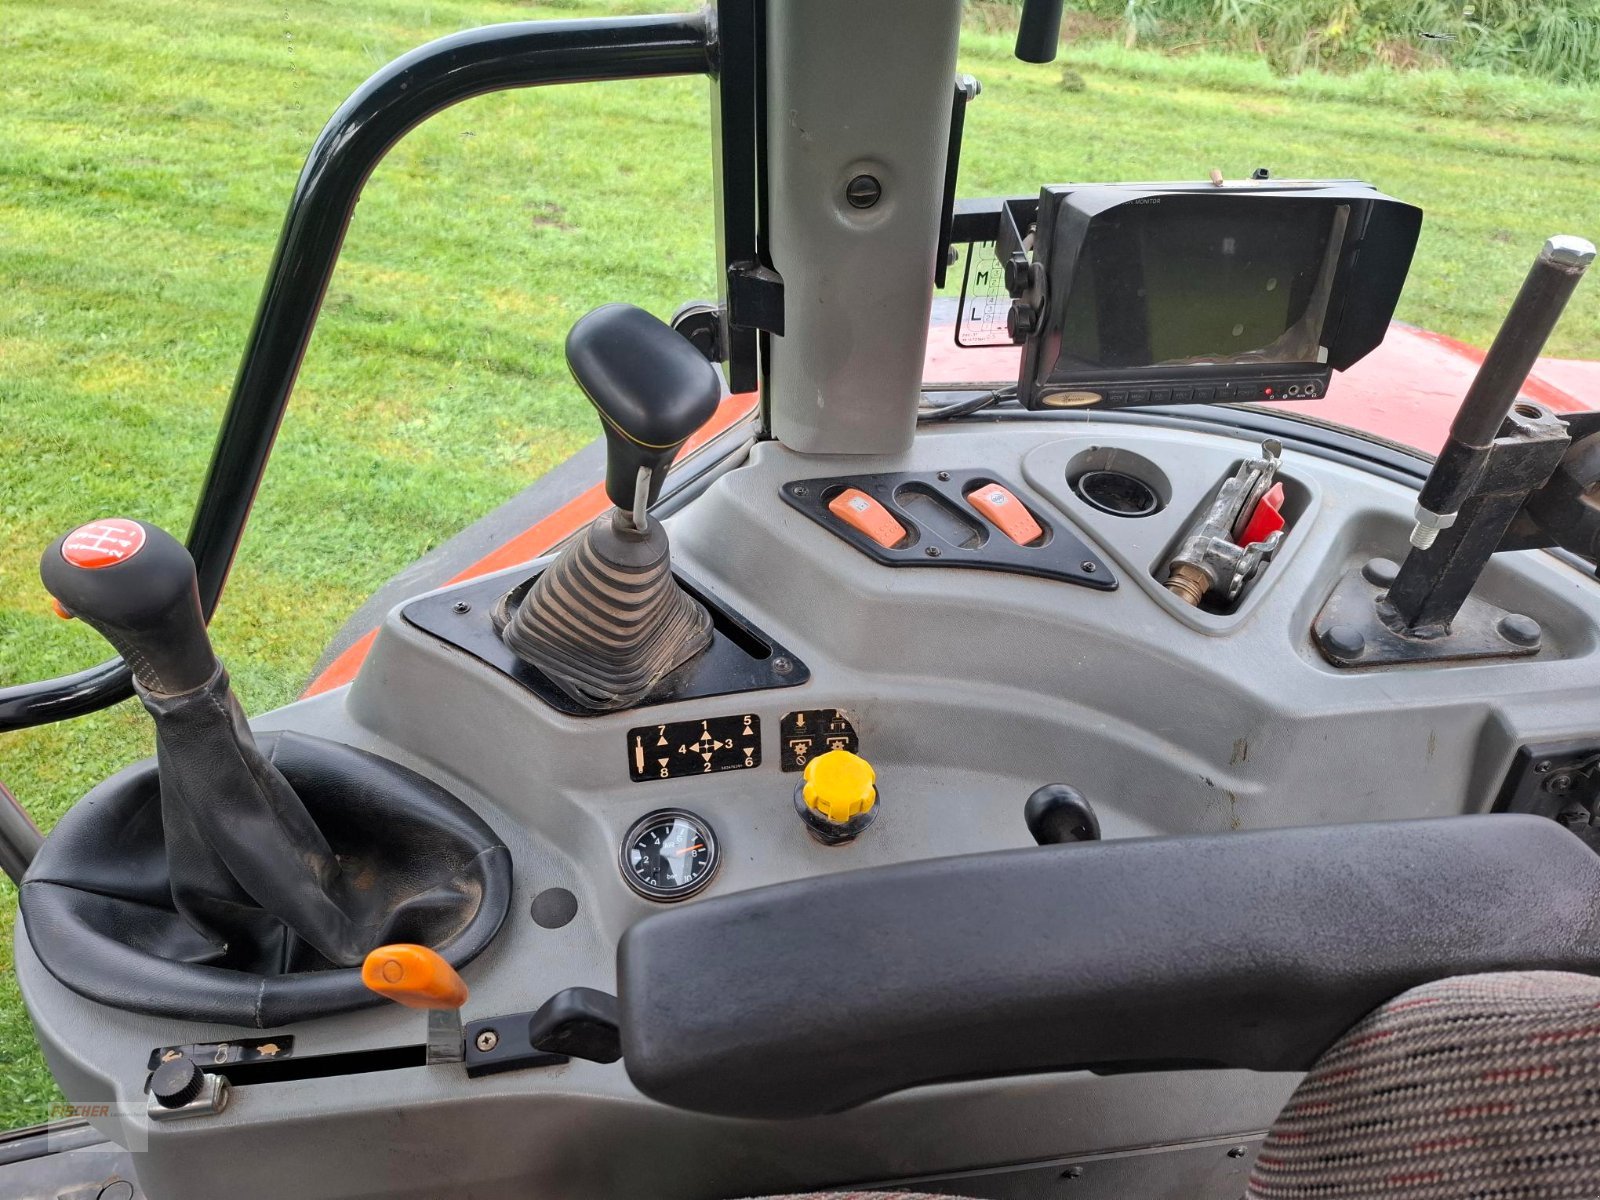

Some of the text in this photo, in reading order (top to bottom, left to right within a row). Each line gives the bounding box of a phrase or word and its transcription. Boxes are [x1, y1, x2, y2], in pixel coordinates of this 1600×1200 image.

[976, 271, 989, 286] M
[971, 307, 982, 321] L
[701, 719, 708, 730] 1
[743, 715, 752, 726] 5
[657, 725, 666, 736] 7
[725, 738, 734, 749] 3
[678, 744, 687, 755] 4
[703, 762, 712, 773] 2
[744, 757, 754, 767] 6
[660, 767, 669, 778] 8
[654, 837, 661, 845] 4
[643, 855, 650, 864] 2
[691, 850, 698, 858] 8
[683, 875, 693, 883] 10
